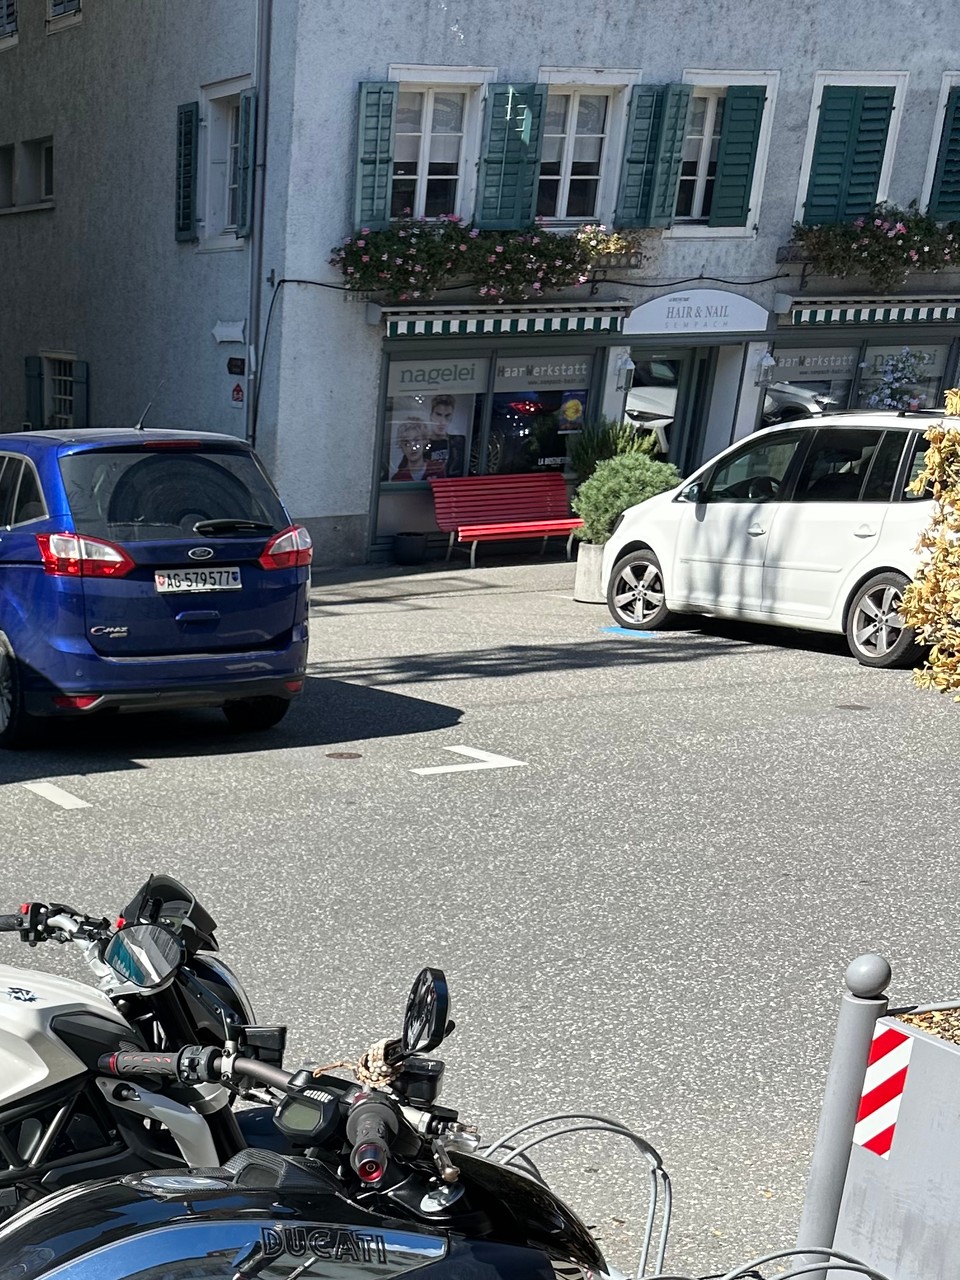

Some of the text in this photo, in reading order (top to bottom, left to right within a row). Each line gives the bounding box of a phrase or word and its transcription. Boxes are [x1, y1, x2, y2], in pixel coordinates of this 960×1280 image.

[666, 305, 729, 319] HAIR & NAIL
[664, 321, 728, 329] SEMPACH
[774, 354, 854, 369] HaarWerkstatt
[400, 362, 476, 386] nagelei
[497, 362, 588, 378] HaarWerkstatt
[261, 1226, 388, 1265] DUCATI
